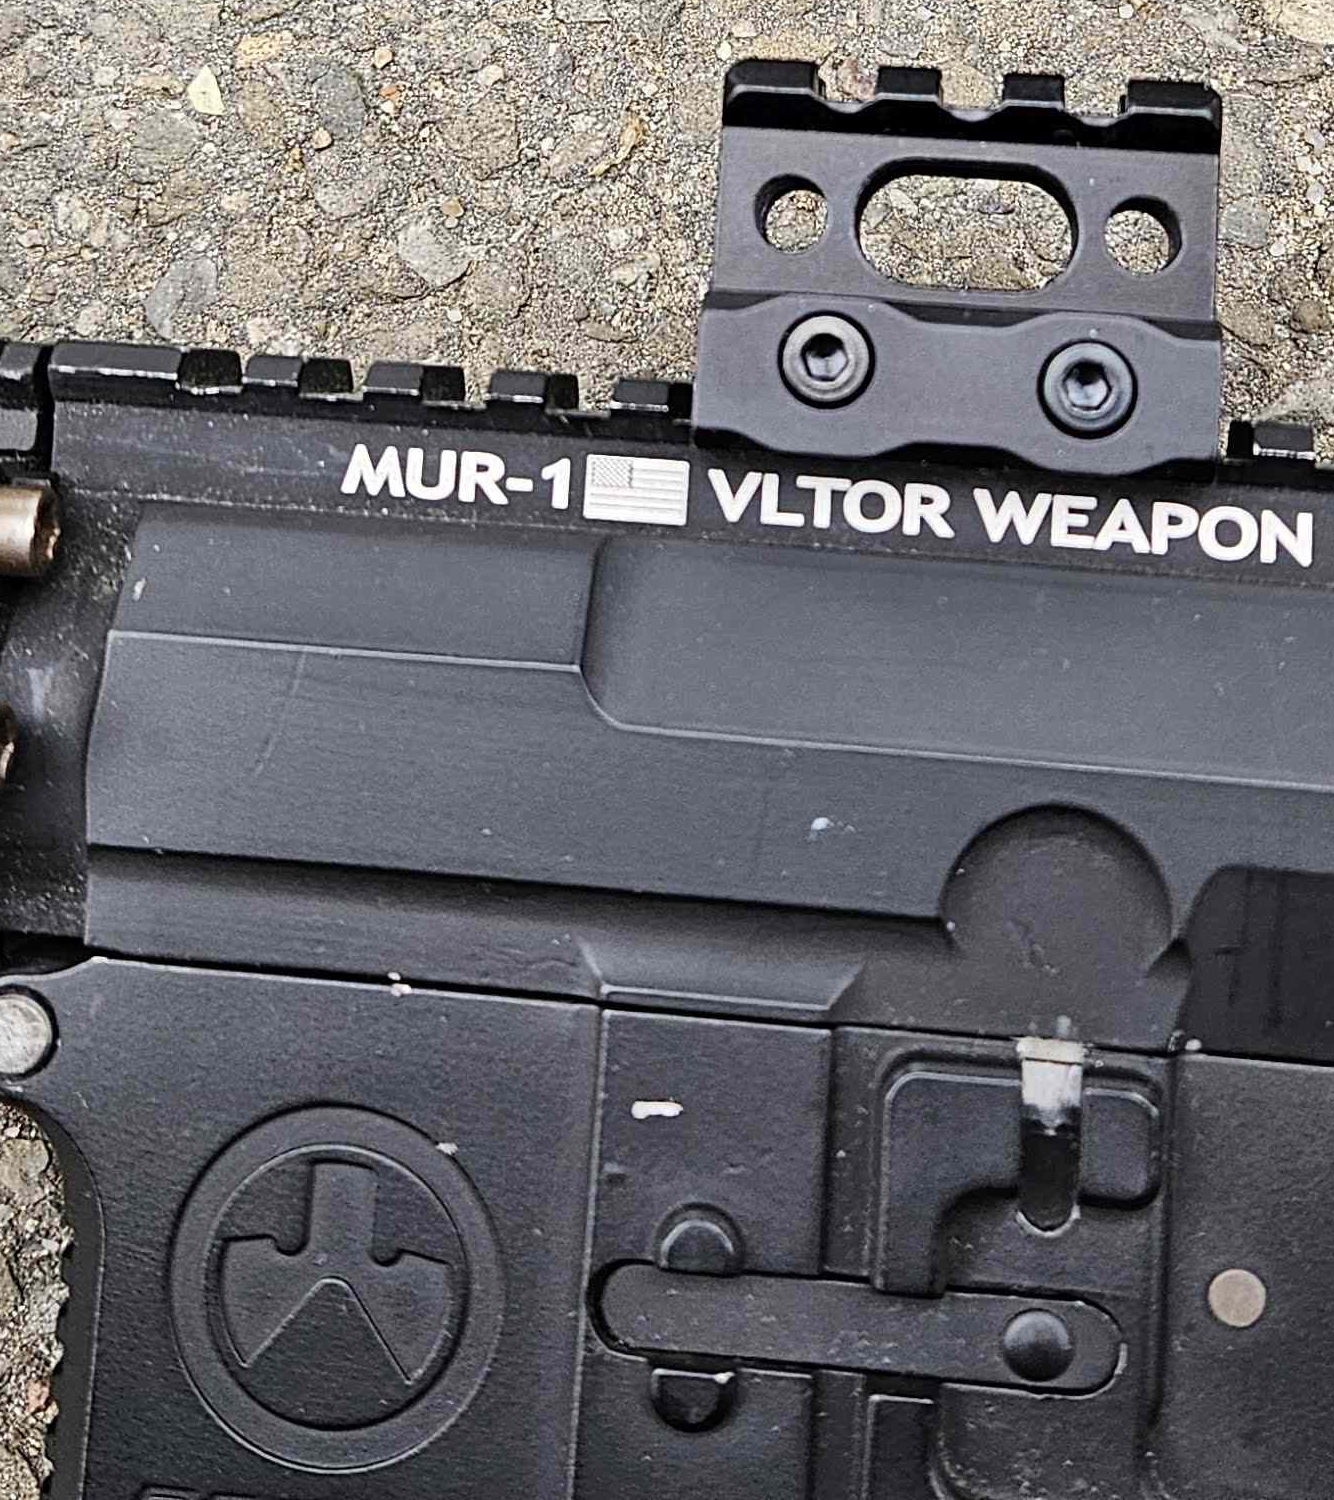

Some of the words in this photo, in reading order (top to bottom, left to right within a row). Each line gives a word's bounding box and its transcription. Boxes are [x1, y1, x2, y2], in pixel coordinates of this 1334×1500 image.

[341, 443, 571, 510] MUR-1
[707, 468, 956, 539] VLTOR
[973, 488, 1313, 568] WEAPON
